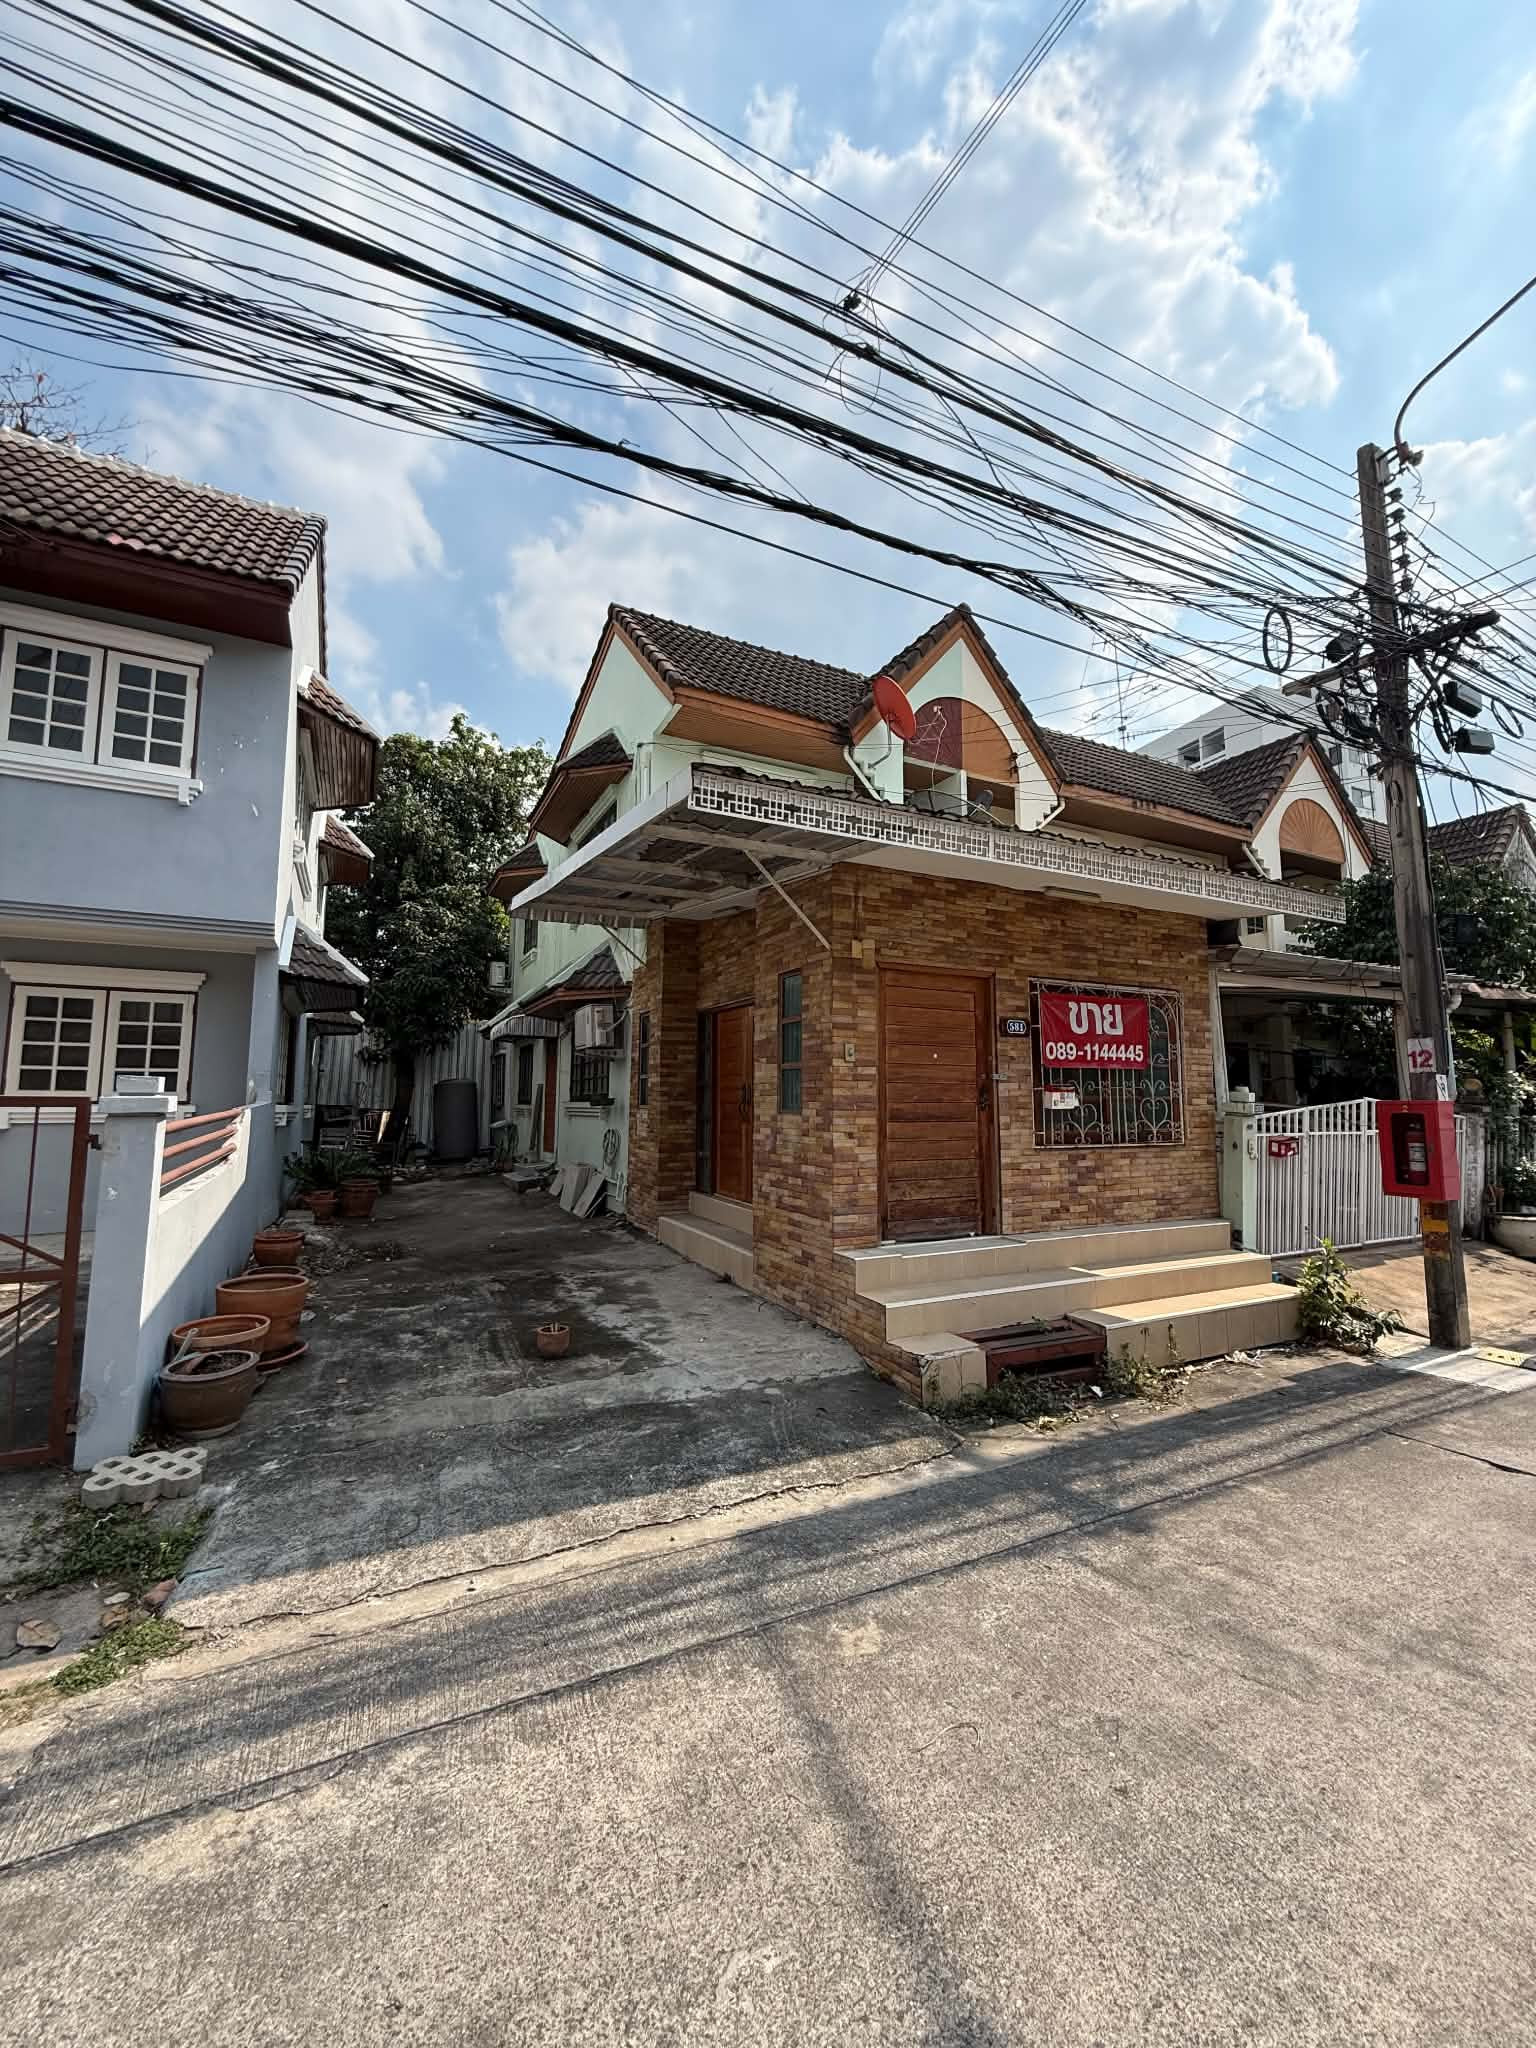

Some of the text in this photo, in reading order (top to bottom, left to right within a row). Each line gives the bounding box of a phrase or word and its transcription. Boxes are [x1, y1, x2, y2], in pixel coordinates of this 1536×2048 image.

[1009, 1022, 1024, 1032] 581
[1068, 1001, 1124, 1036] ขาย
[1046, 1041, 1144, 1062] 089-1144445
[1408, 1050, 1433, 1068] 12
